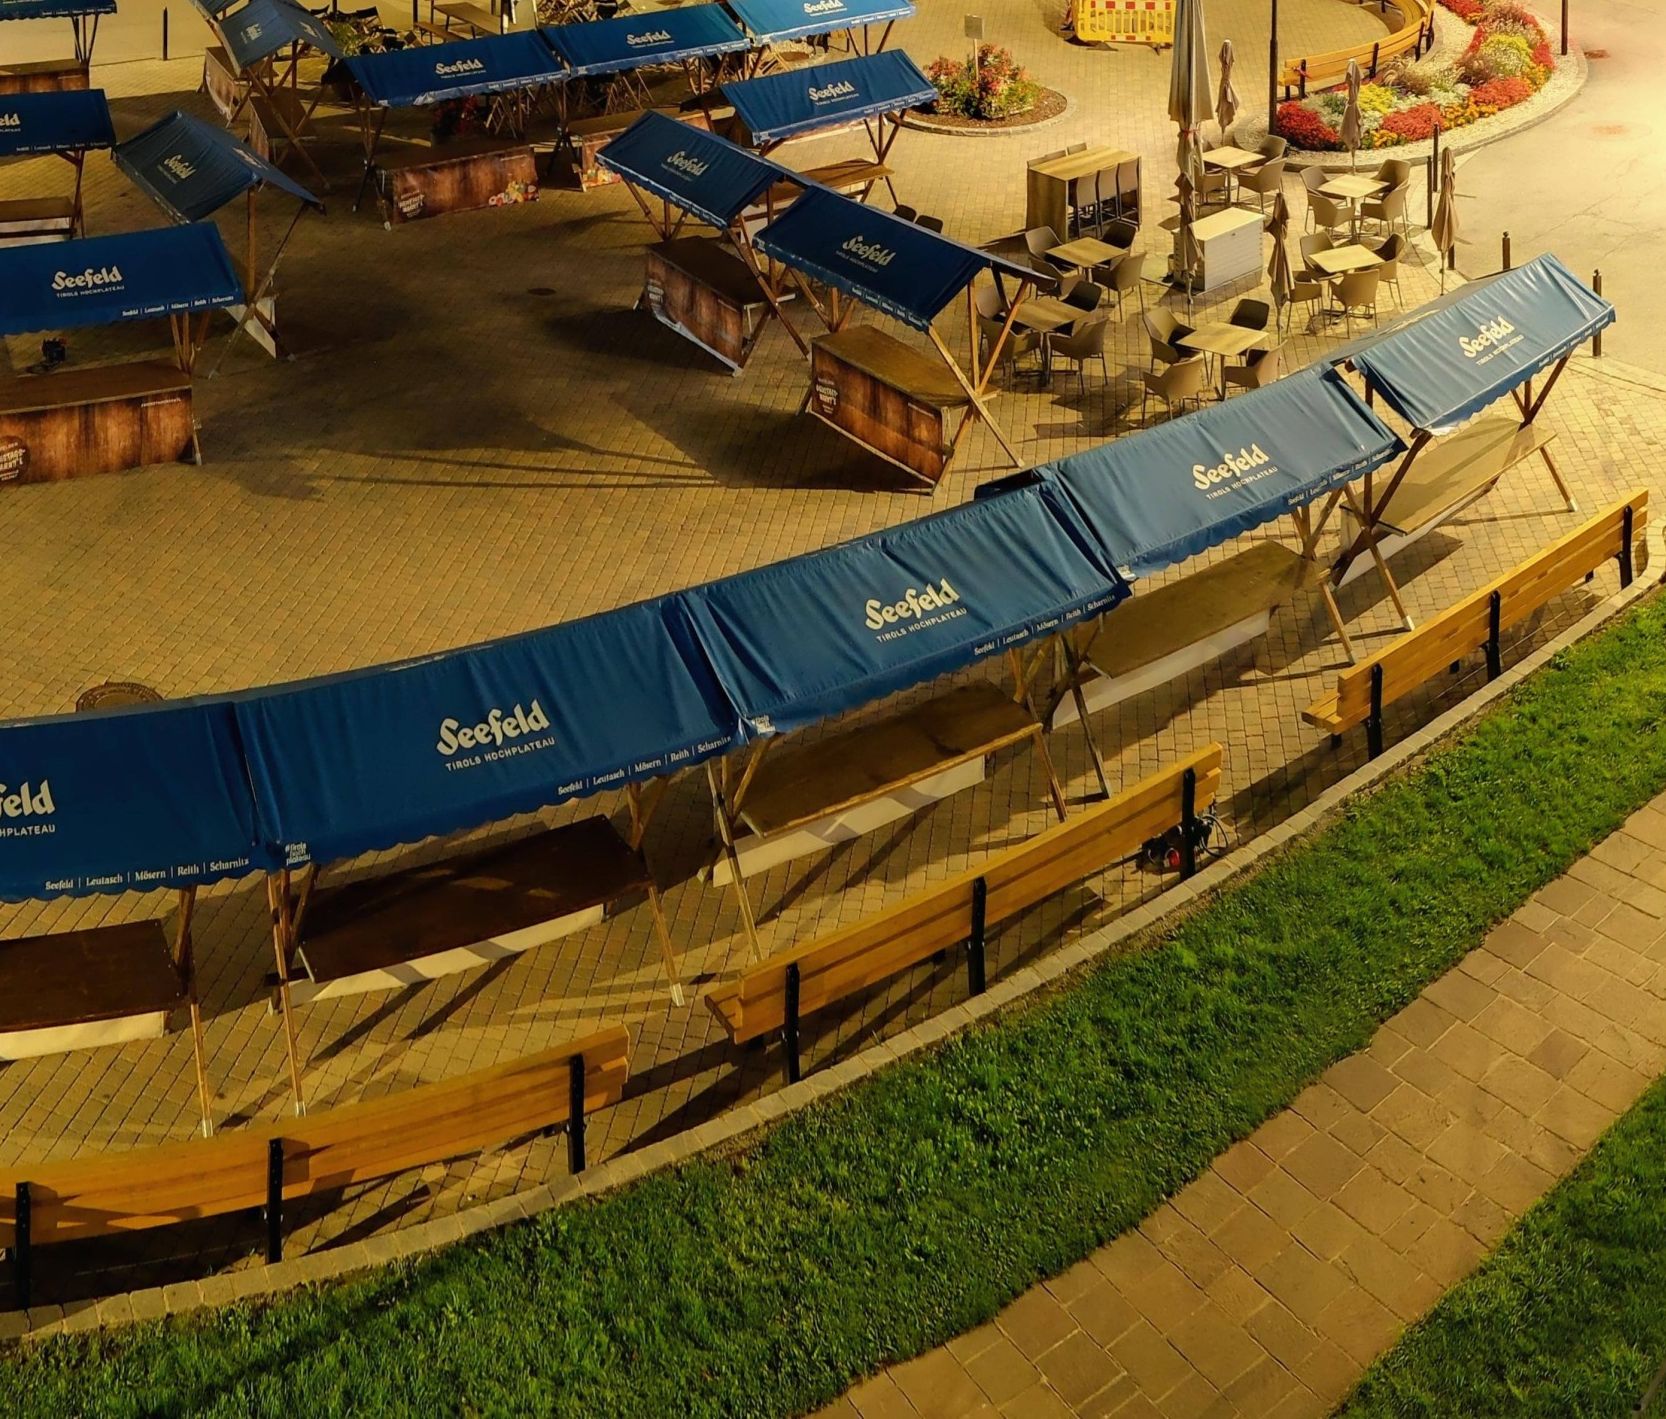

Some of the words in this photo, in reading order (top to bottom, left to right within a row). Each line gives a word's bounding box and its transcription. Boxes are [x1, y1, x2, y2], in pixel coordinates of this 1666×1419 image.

[627, 29, 671, 45] Seefeld
[436, 58, 484, 75] Seefeld
[808, 81, 855, 101] Seefeld
[667, 150, 709, 176] Seefeld
[842, 235, 896, 266] Seefeld
[51, 265, 123, 291] Seefeld
[56, 289, 78, 299] TIROLS
[1459, 315, 1516, 359] Seefeld
[1193, 442, 1270, 491] Seefeld
[1205, 486, 1231, 501] TIROLS
[1231, 465, 1279, 492] HOCHPLATEAU
[865, 577, 961, 631] Seefeld
[876, 627, 907, 644] TIROLS
[907, 607, 968, 636] HOCHPLATEAU
[973, 638, 995, 656] Seefeld
[1001, 629, 1030, 647] Leutasch
[1065, 606, 1082, 623] Reith
[436, 698, 551, 756] Seefeld
[445, 754, 482, 772] TIROLS
[483, 736, 556, 762] HOCHPLATEAU
[557, 779, 583, 796] Seefeld
[592, 768, 625, 786] Leutasch
[633, 758, 662, 774] Mösern
[669, 747, 690, 763] Reith
[696, 735, 732, 755] Scharnitz
[44, 877, 74, 891] Seefeld
[85, 873, 123, 887] Leutasch
[134, 868, 167, 883] Mösern
[176, 863, 200, 878] Reith
[209, 856, 250, 873] Scharnitz
